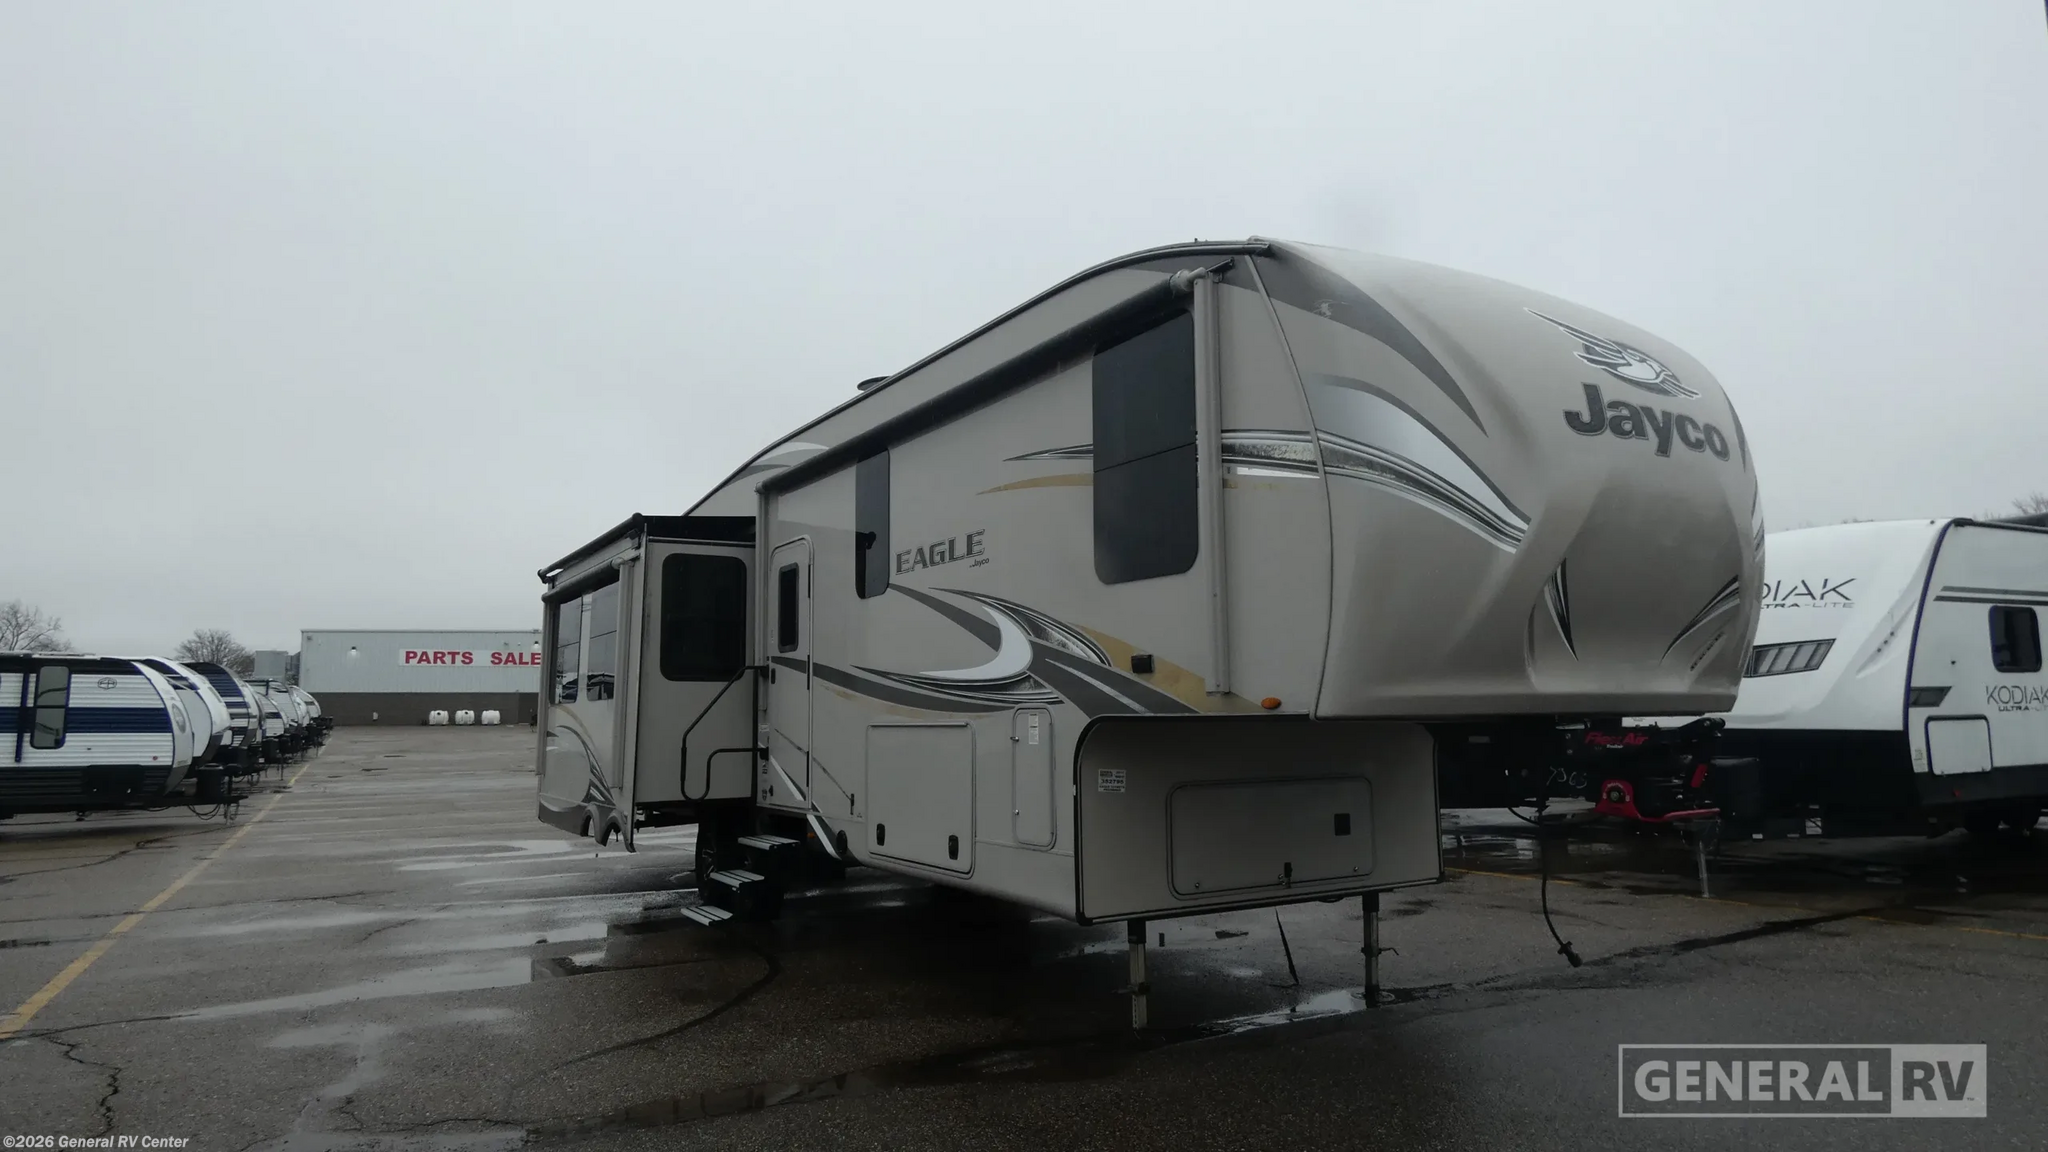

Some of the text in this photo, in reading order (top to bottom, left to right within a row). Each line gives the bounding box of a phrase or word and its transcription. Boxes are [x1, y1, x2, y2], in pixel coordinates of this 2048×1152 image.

[1562, 381, 1730, 462] Jayco
[895, 528, 986, 576] EAGLE
[1761, 578, 1857, 602] IAK
[1760, 601, 1856, 610] TRA-LITE
[404, 650, 542, 666] PARTS SALE
[1985, 685, 2048, 705] KODIAK
